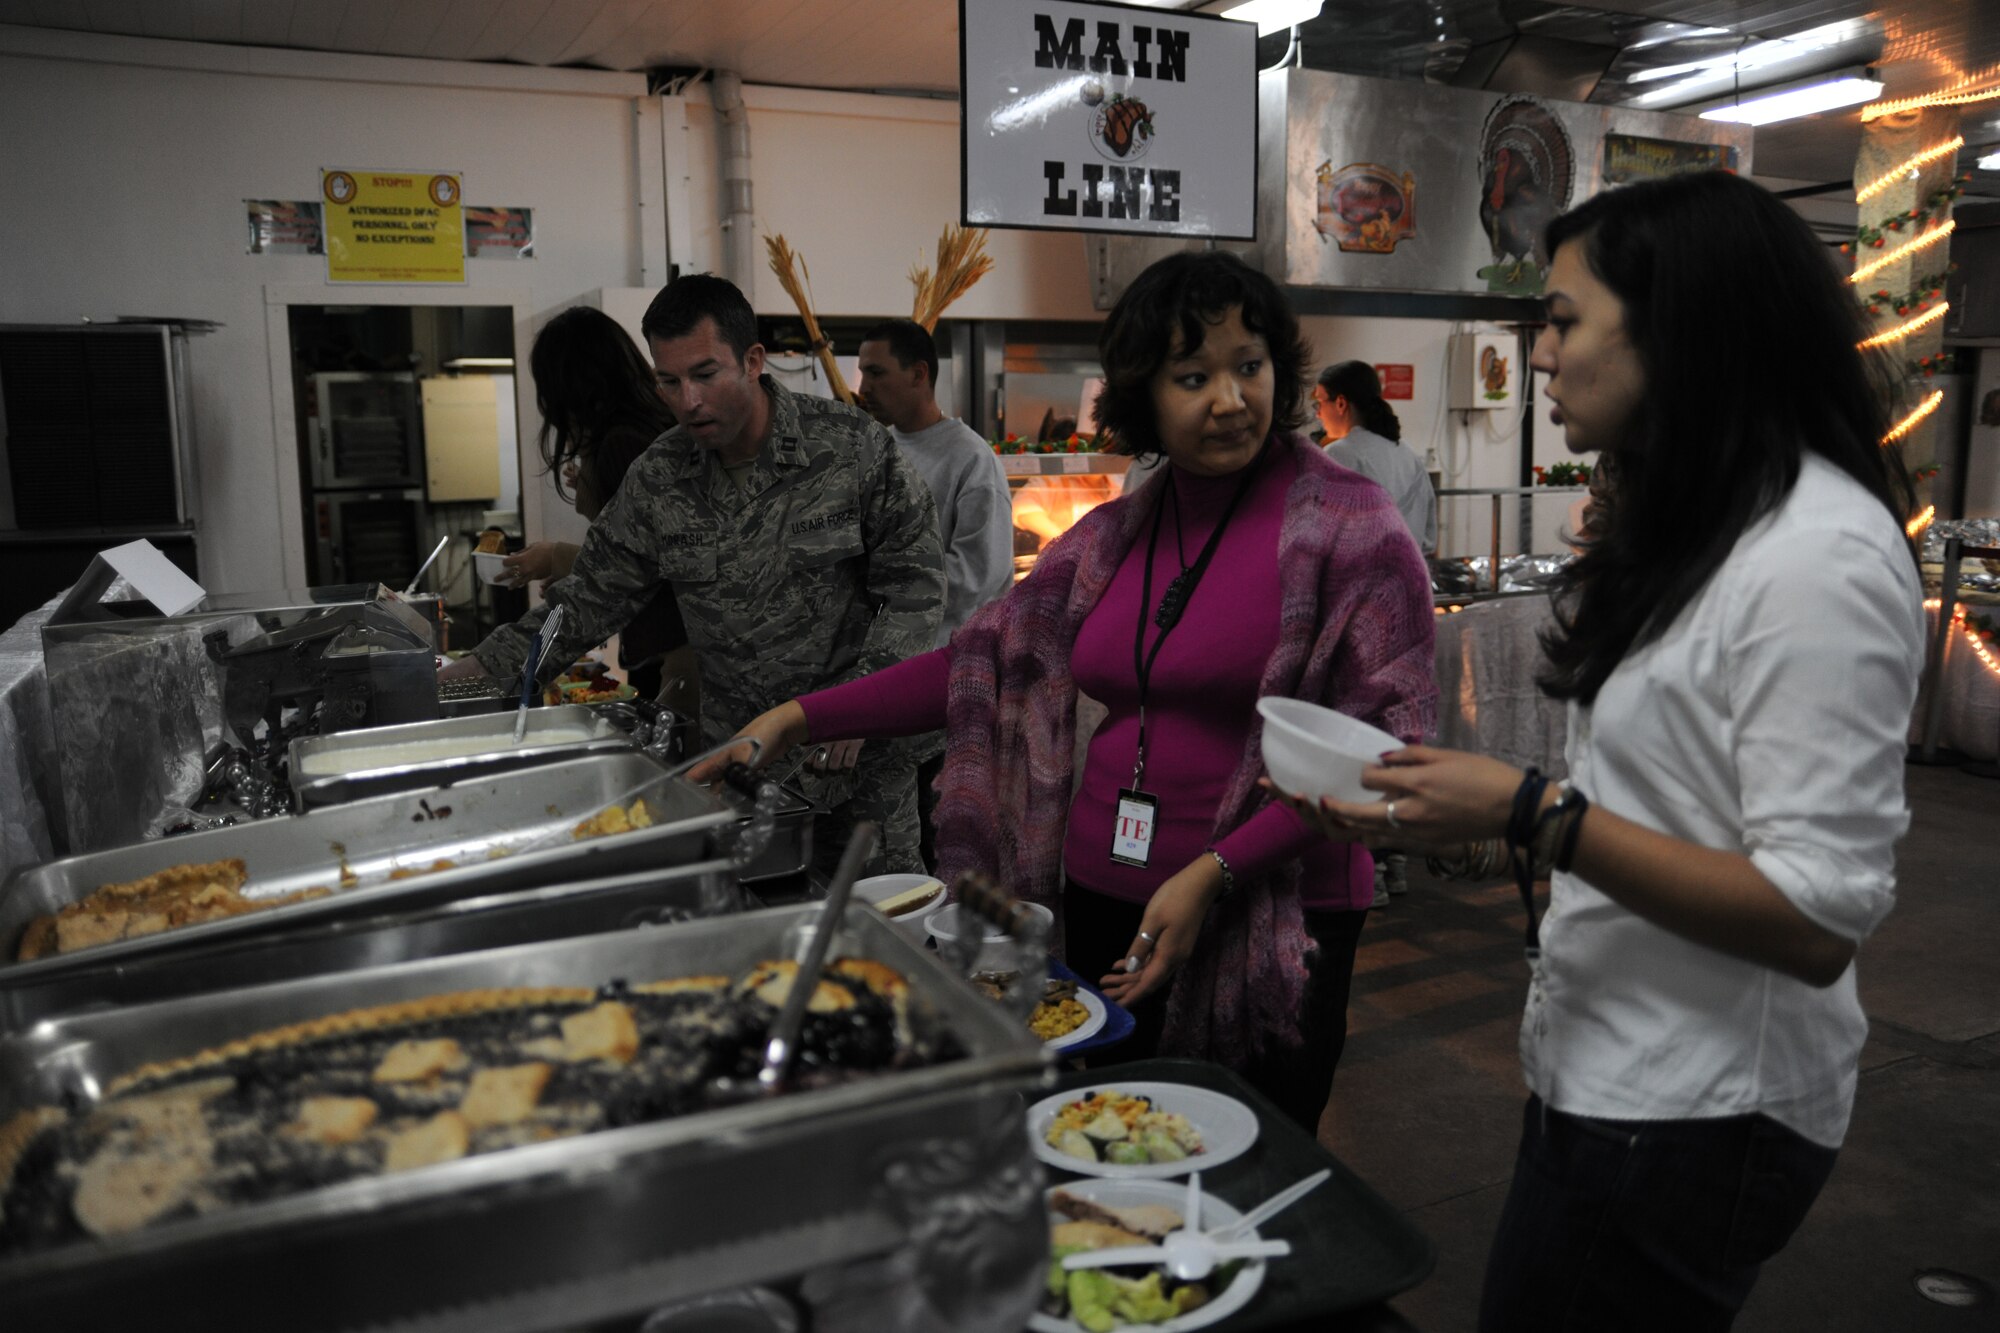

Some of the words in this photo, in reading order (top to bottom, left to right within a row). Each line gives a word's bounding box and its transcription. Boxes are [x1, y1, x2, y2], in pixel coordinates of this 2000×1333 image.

[1034, 14, 1190, 82] MAIN
[1044, 161, 1180, 222] LINE
[348, 206, 411, 216] AUTHORIZED
[414, 207, 440, 216] DFAC
[352, 220, 409, 230] PERSONNEL
[412, 220, 437, 230] ONLY
[355, 234, 369, 243] NO
[372, 234, 435, 244] EXCEPTIONS!
[827, 509, 855, 527] FORCE
[1119, 816, 1148, 841] TE
